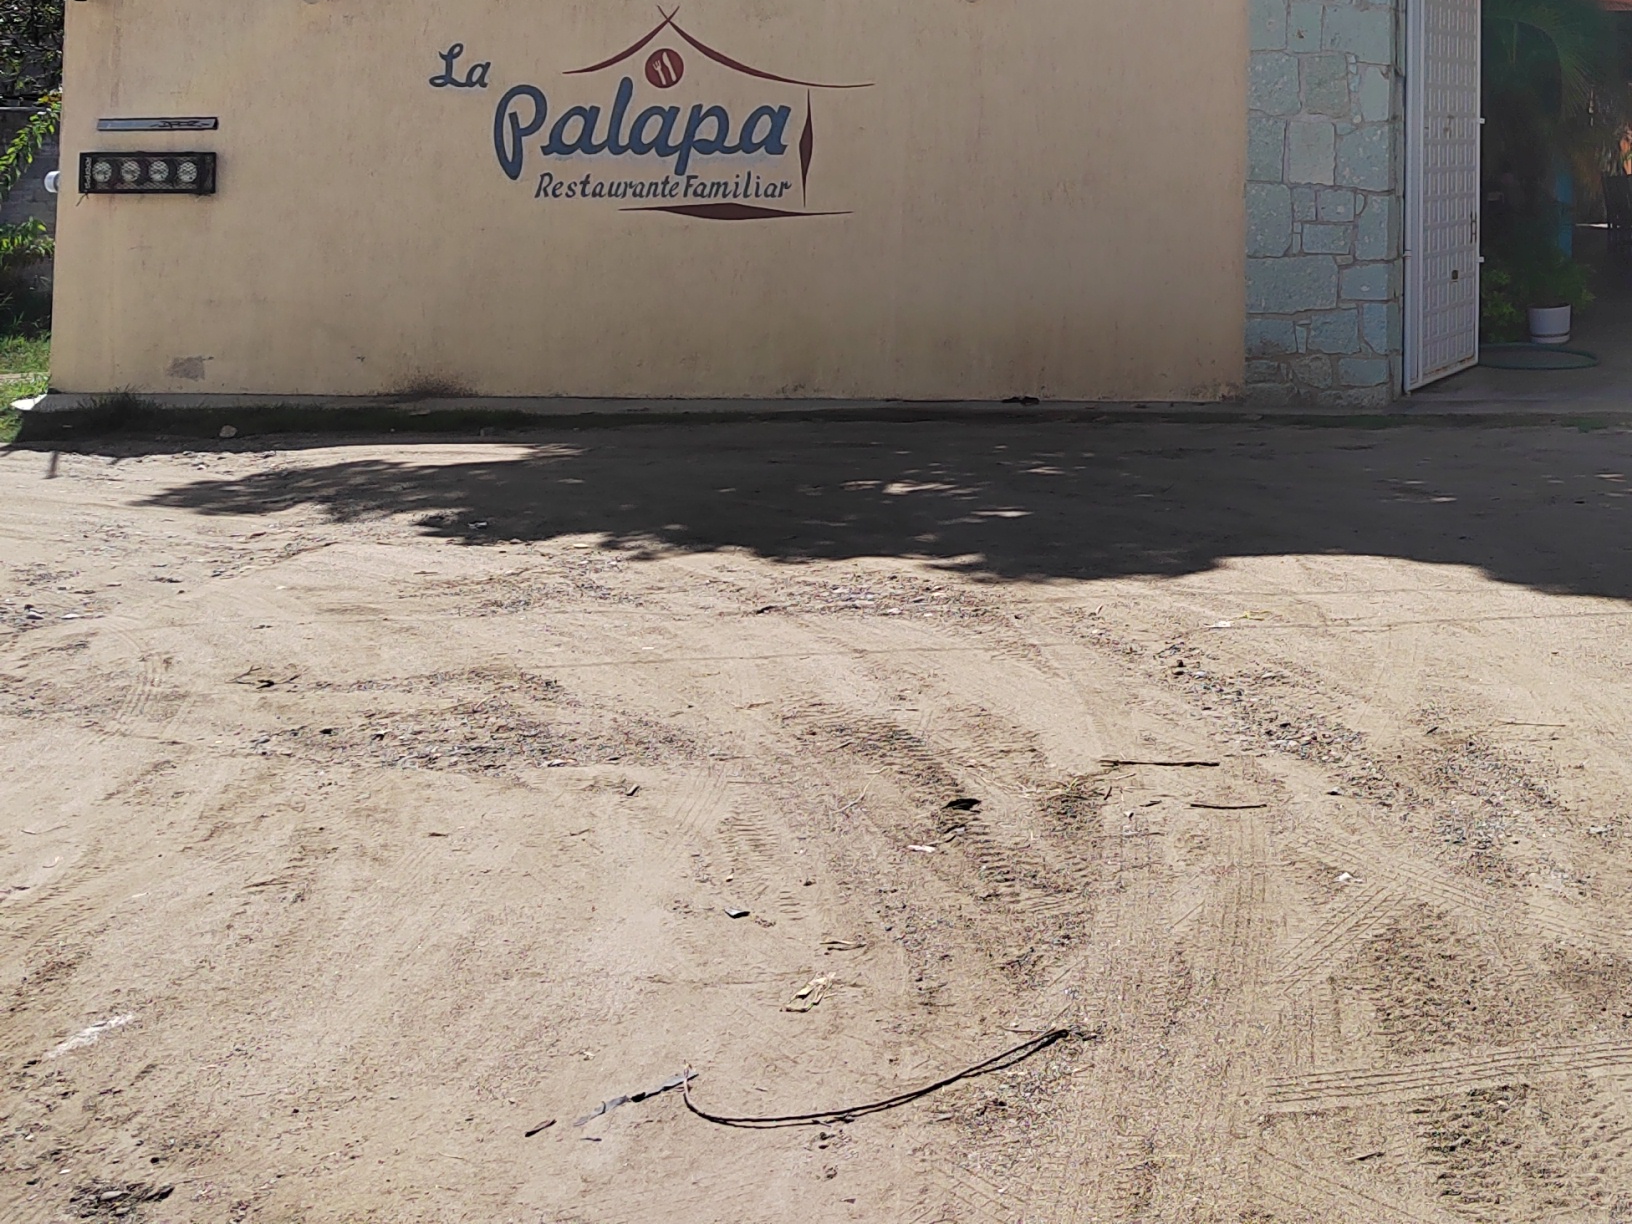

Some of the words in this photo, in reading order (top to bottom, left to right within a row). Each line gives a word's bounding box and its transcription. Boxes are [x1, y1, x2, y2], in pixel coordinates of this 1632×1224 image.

[429, 43, 491, 88] La
[494, 77, 791, 180] Palapa
[534, 172, 680, 198] Restaurante
[683, 170, 792, 198] Familiar
